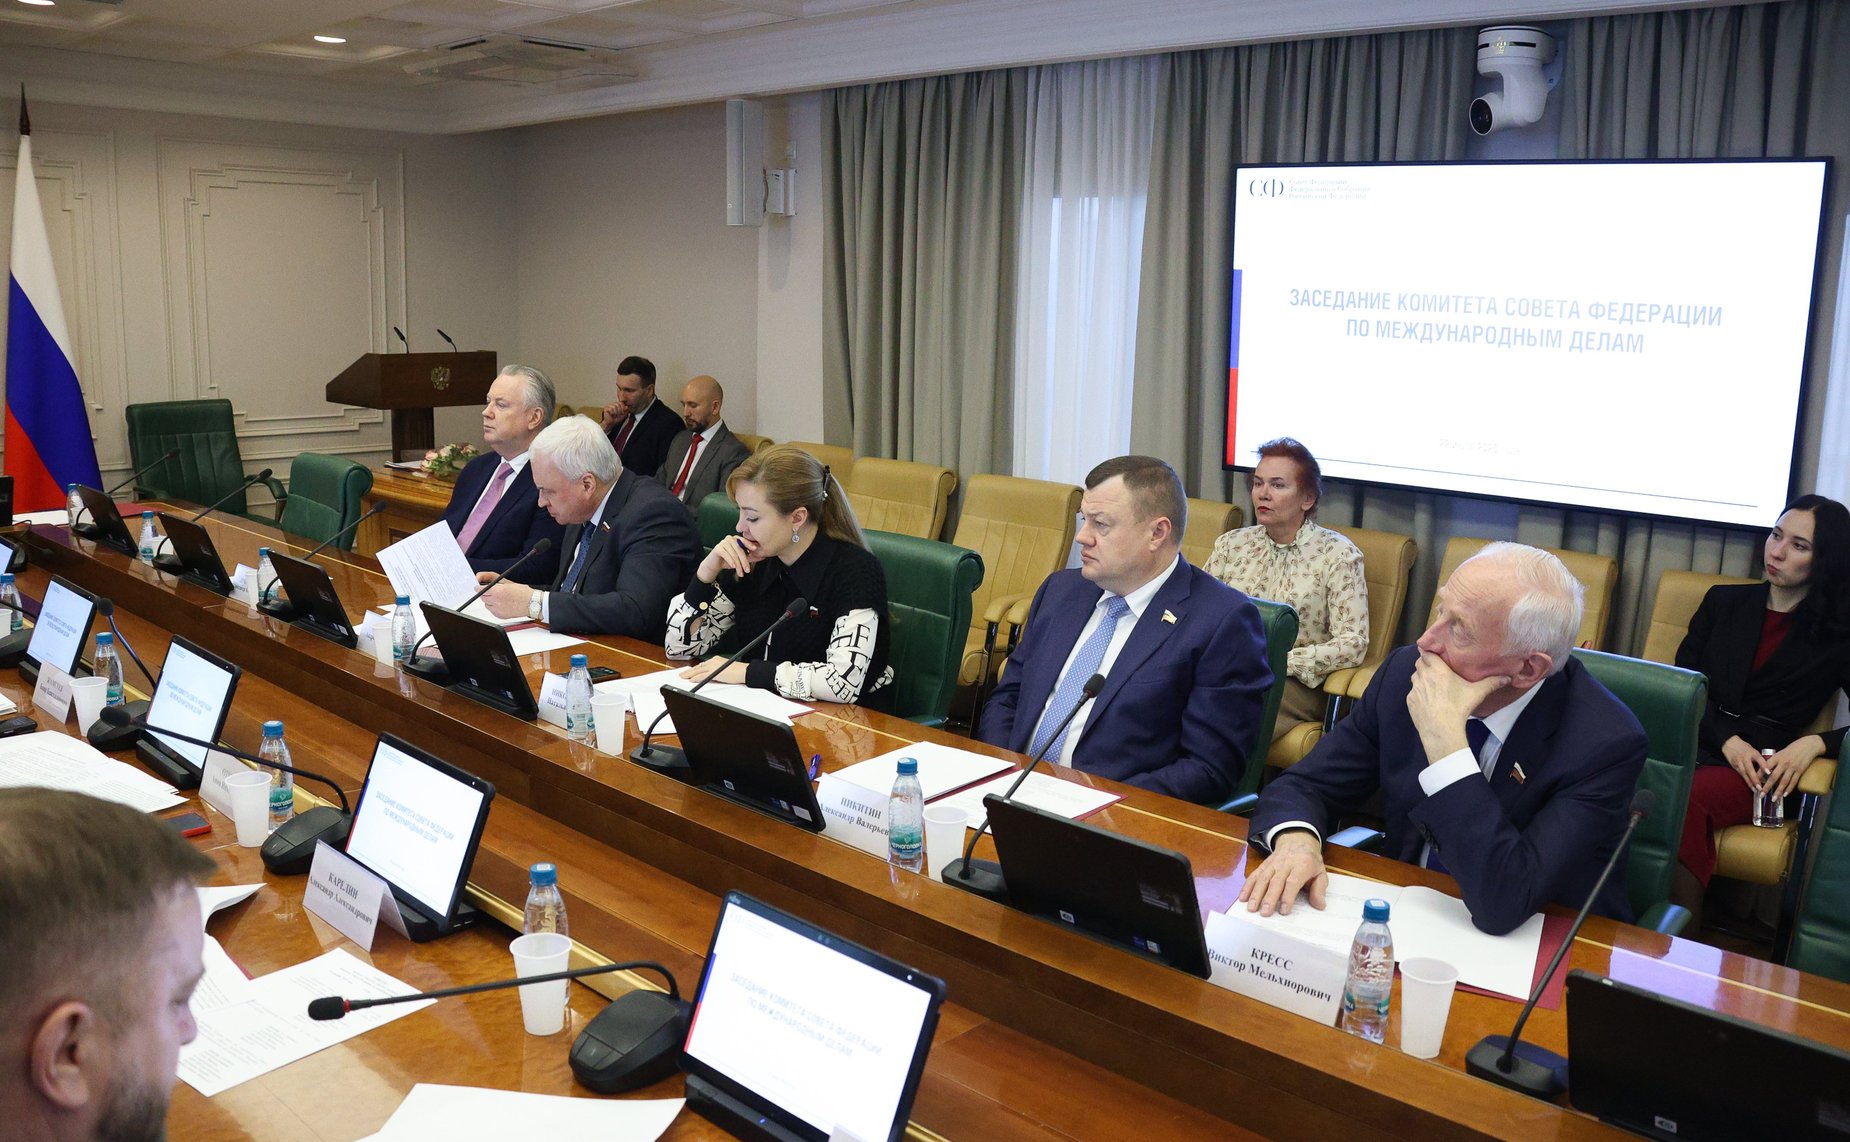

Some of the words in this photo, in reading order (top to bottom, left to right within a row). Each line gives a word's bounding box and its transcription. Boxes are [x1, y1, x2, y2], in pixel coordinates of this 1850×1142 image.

[1289, 288, 1392, 312] ЗАСЕДАНИЕ
[1397, 292, 1499, 316] КОМИТЕТА
[1504, 296, 1582, 320] СОВЕТА
[1588, 300, 1723, 327] ФЕДЕРАЦИИ
[1346, 318, 1370, 337] ПО
[1375, 320, 1563, 349] МЕЖДУНАРОДНЫМ
[1568, 330, 1645, 354] ДЕЛАМ
[819, 803, 855, 825] Александр
[856, 816, 890, 836] Валерьев
[840, 797, 882, 820] НИКИТИН
[310, 876, 334, 899] Александр
[335, 893, 373, 925] Александрович
[328, 872, 359, 900] КАРЕЛИН
[1208, 947, 1246, 972] Виктор
[1248, 963, 1332, 1003] Мельхиорович
[1250, 948, 1294, 971] КРЕСС
